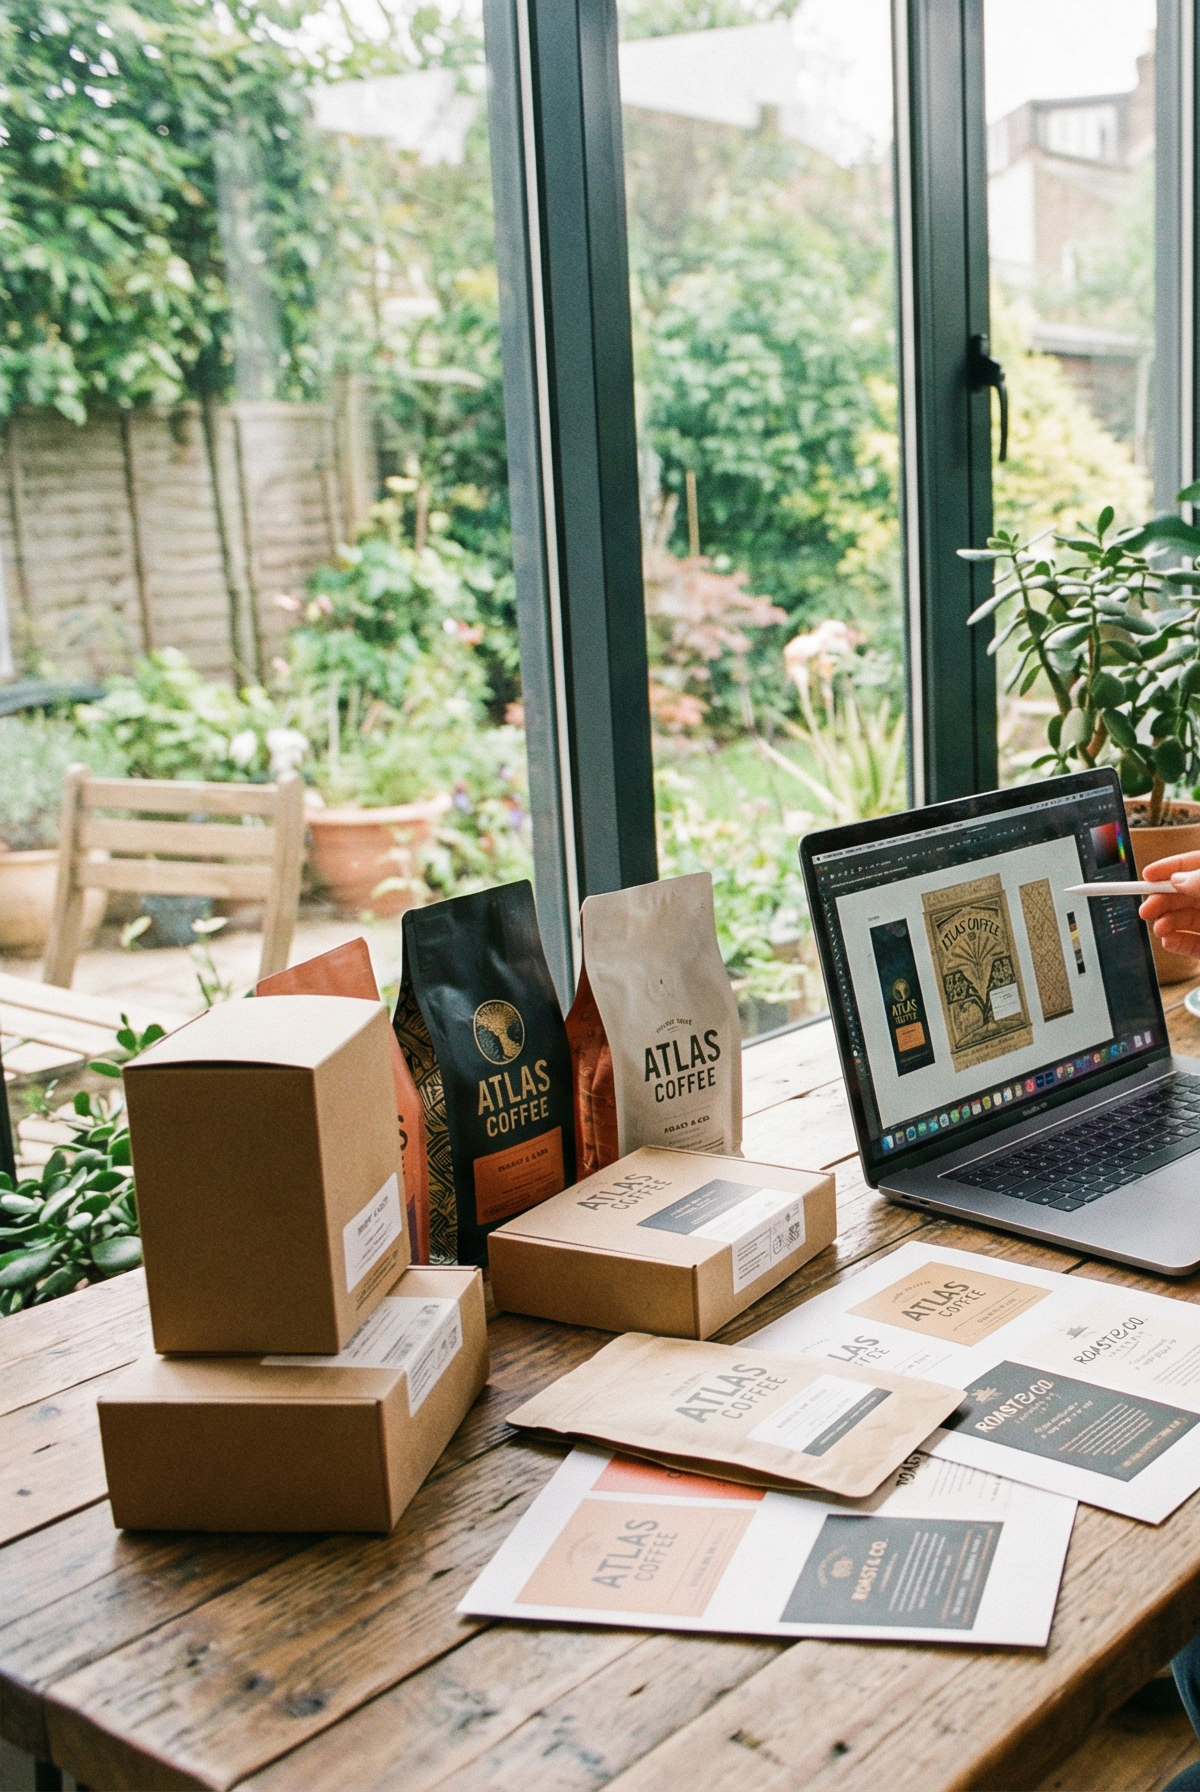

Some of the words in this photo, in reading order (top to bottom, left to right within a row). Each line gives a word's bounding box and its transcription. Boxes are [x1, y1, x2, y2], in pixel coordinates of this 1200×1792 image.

[644, 1029, 721, 1082] ATLAS
[477, 1059, 551, 1116] ATLAS
[654, 1067, 717, 1103] COFFEE
[486, 1096, 549, 1138] COFFEE
[576, 1173, 653, 1211] ATLAS
[901, 1280, 970, 1322] ATLAS
[938, 1289, 987, 1318] COFFEE
[826, 1335, 880, 1363] LAS
[674, 1363, 768, 1424] ATLAS
[721, 1375, 788, 1420] COFFEE
[590, 1518, 659, 1590] ATLAS
[634, 1532, 678, 1582] COFFEE
